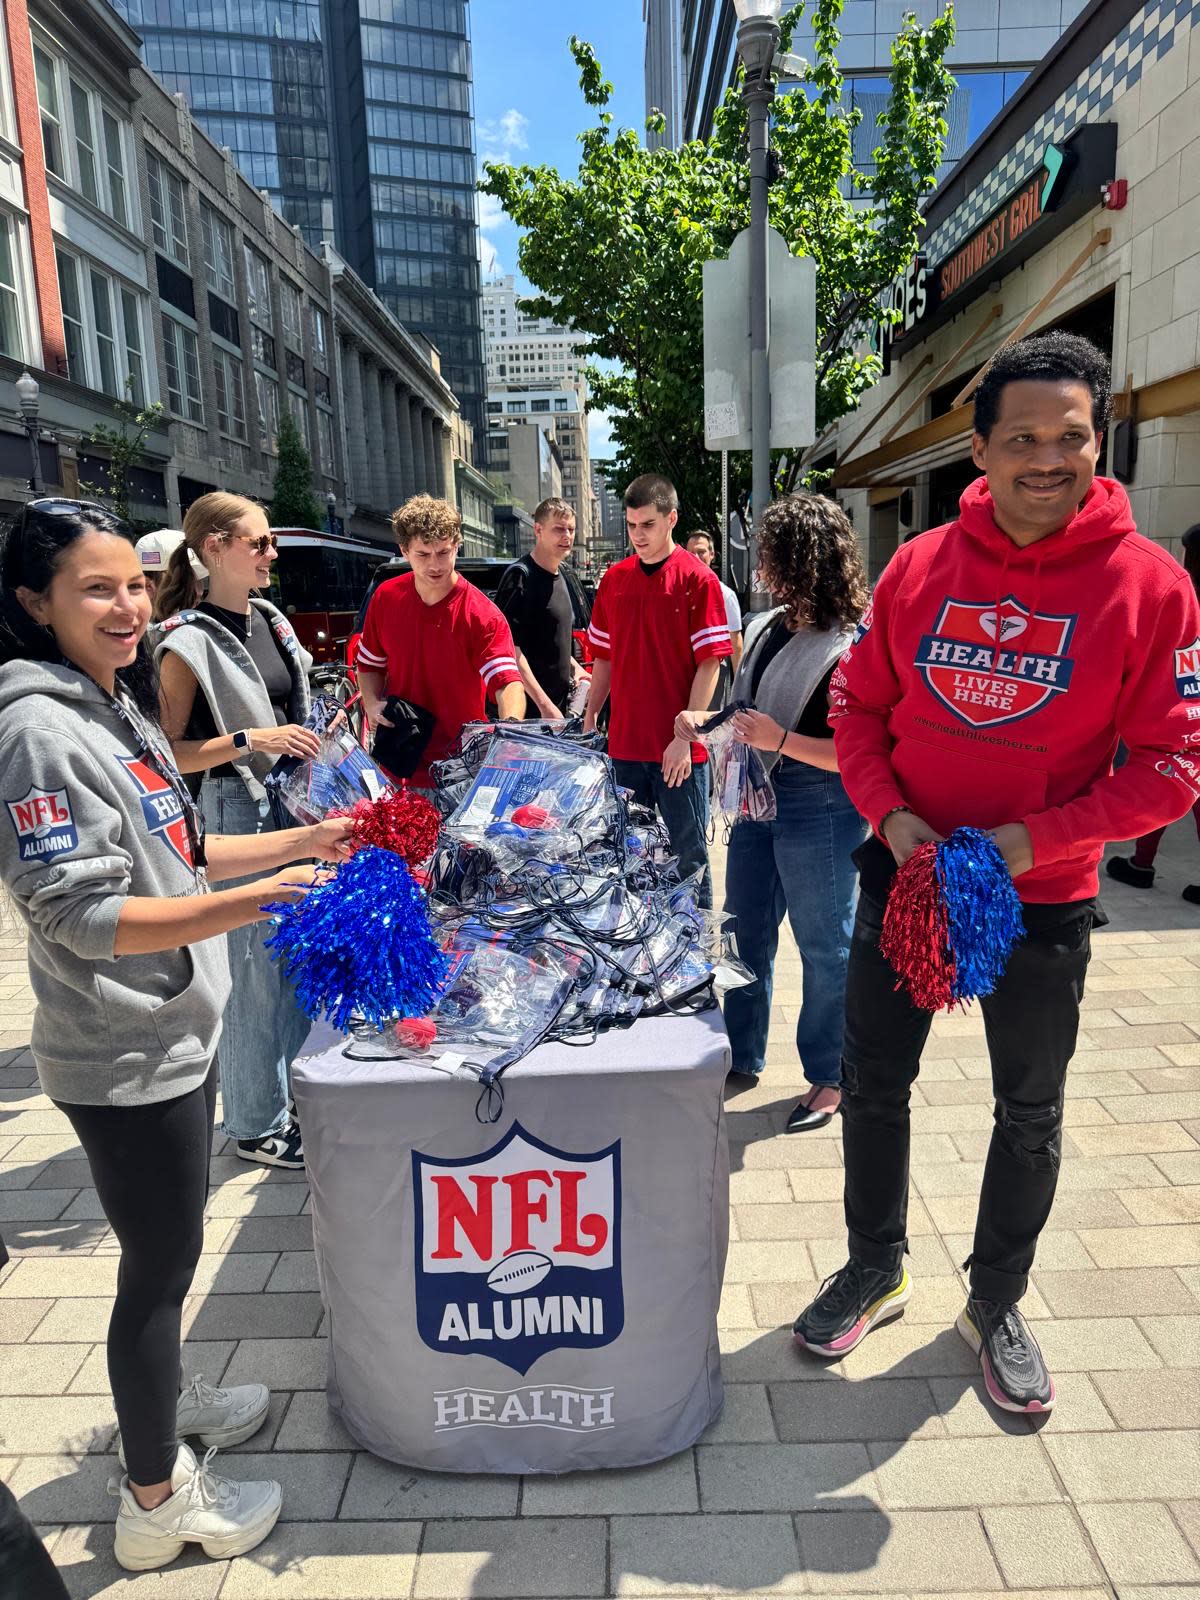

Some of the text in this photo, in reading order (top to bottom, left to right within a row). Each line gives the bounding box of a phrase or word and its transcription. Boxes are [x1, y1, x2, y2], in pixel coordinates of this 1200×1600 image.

[940, 172, 1048, 301] SOUTHWEST GRiL
[927, 641, 1061, 682] HEALTH
[953, 673, 1018, 697] LIVES
[953, 688, 1014, 711] HERE
[13, 795, 69, 832] NFL
[23, 834, 73, 858] ALUMNI
[430, 1170, 608, 1261] NFL
[438, 1296, 604, 1341] ALUMNI
[434, 1390, 615, 1427] HEALTH
